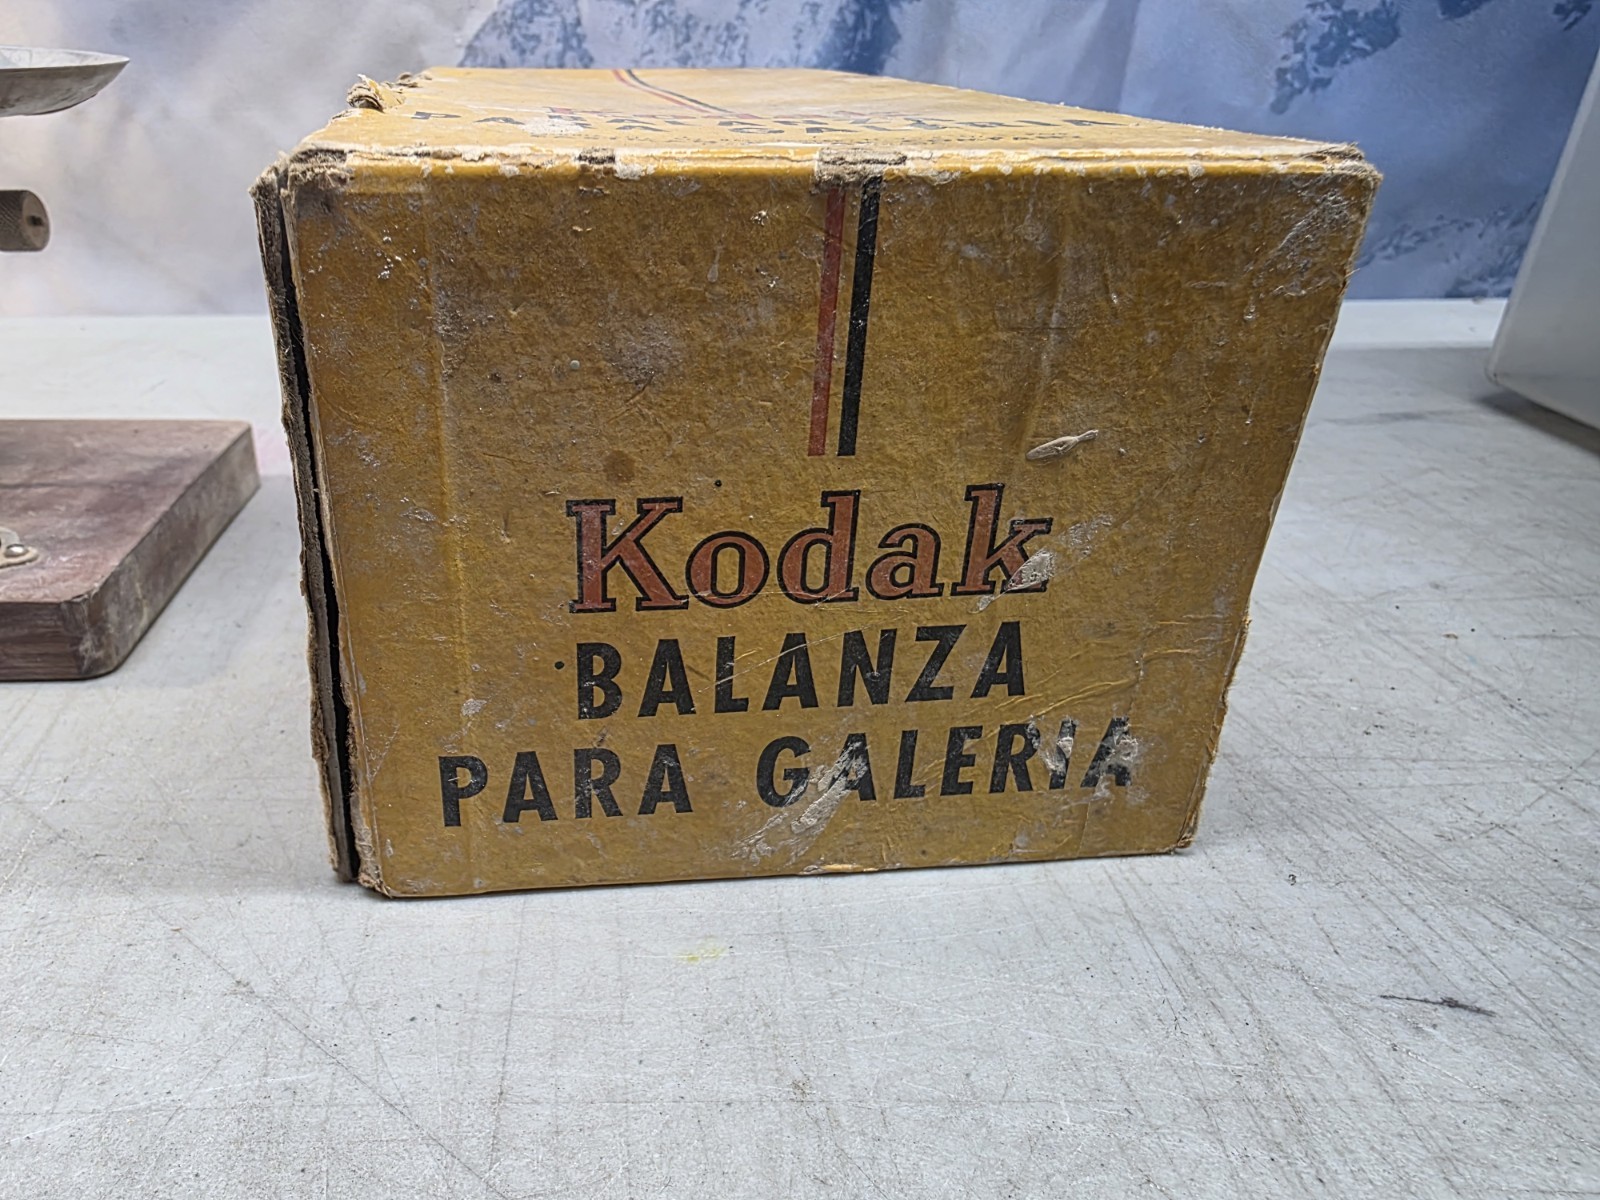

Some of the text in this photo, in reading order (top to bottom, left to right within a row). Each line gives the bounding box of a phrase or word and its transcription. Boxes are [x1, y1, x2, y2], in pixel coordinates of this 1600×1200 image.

[565, 482, 1053, 614] Kodak
[576, 621, 1026, 720] BALANZA
[438, 716, 1134, 827] PARA GALERIA
